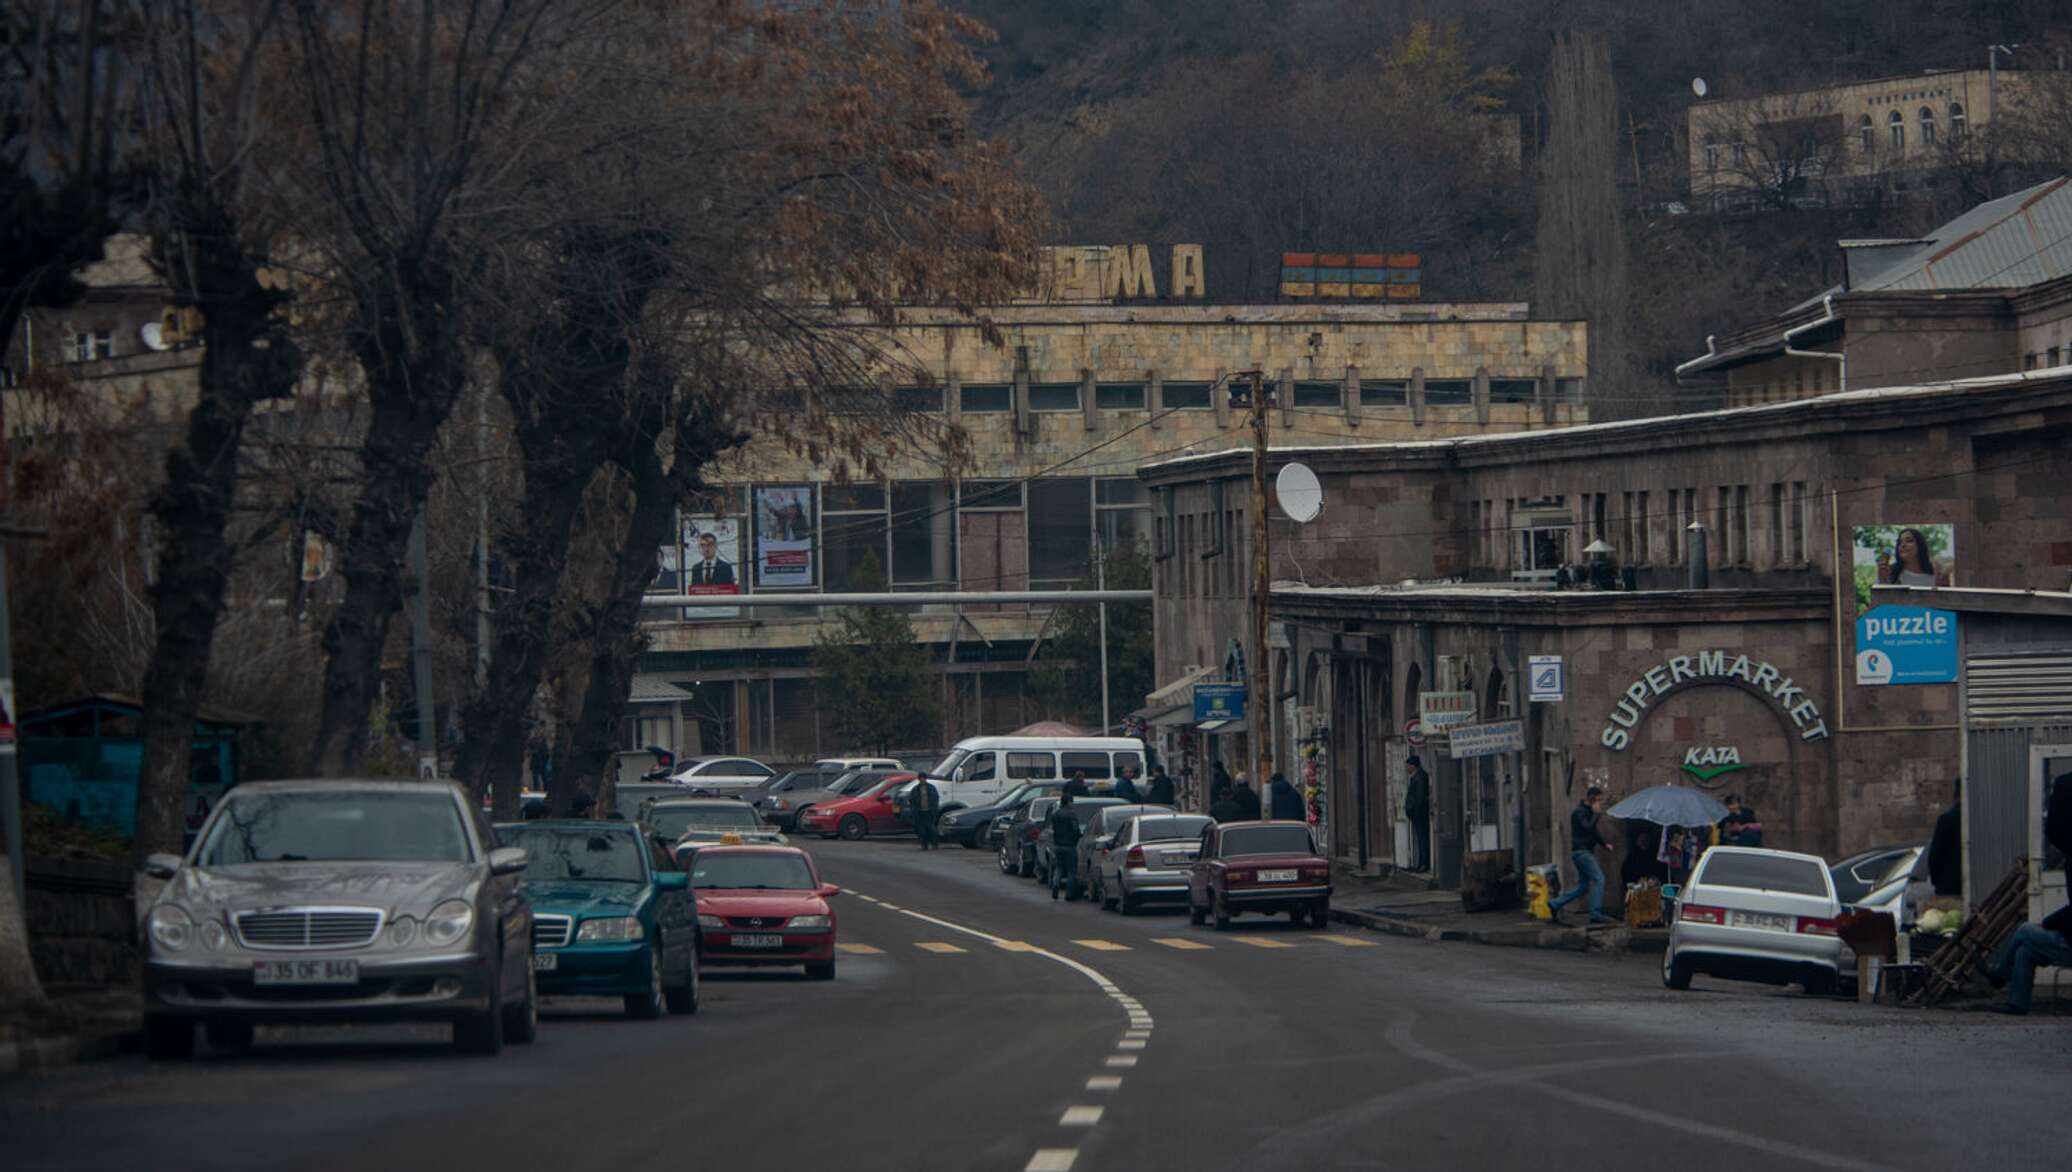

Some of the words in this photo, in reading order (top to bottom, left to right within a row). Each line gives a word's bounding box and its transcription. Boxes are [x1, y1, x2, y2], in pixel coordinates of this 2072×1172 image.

[1865, 611, 1947, 641] puzzle
[1601, 650, 1829, 750] SUPERMARKET
[1684, 746, 1741, 765] KATA
